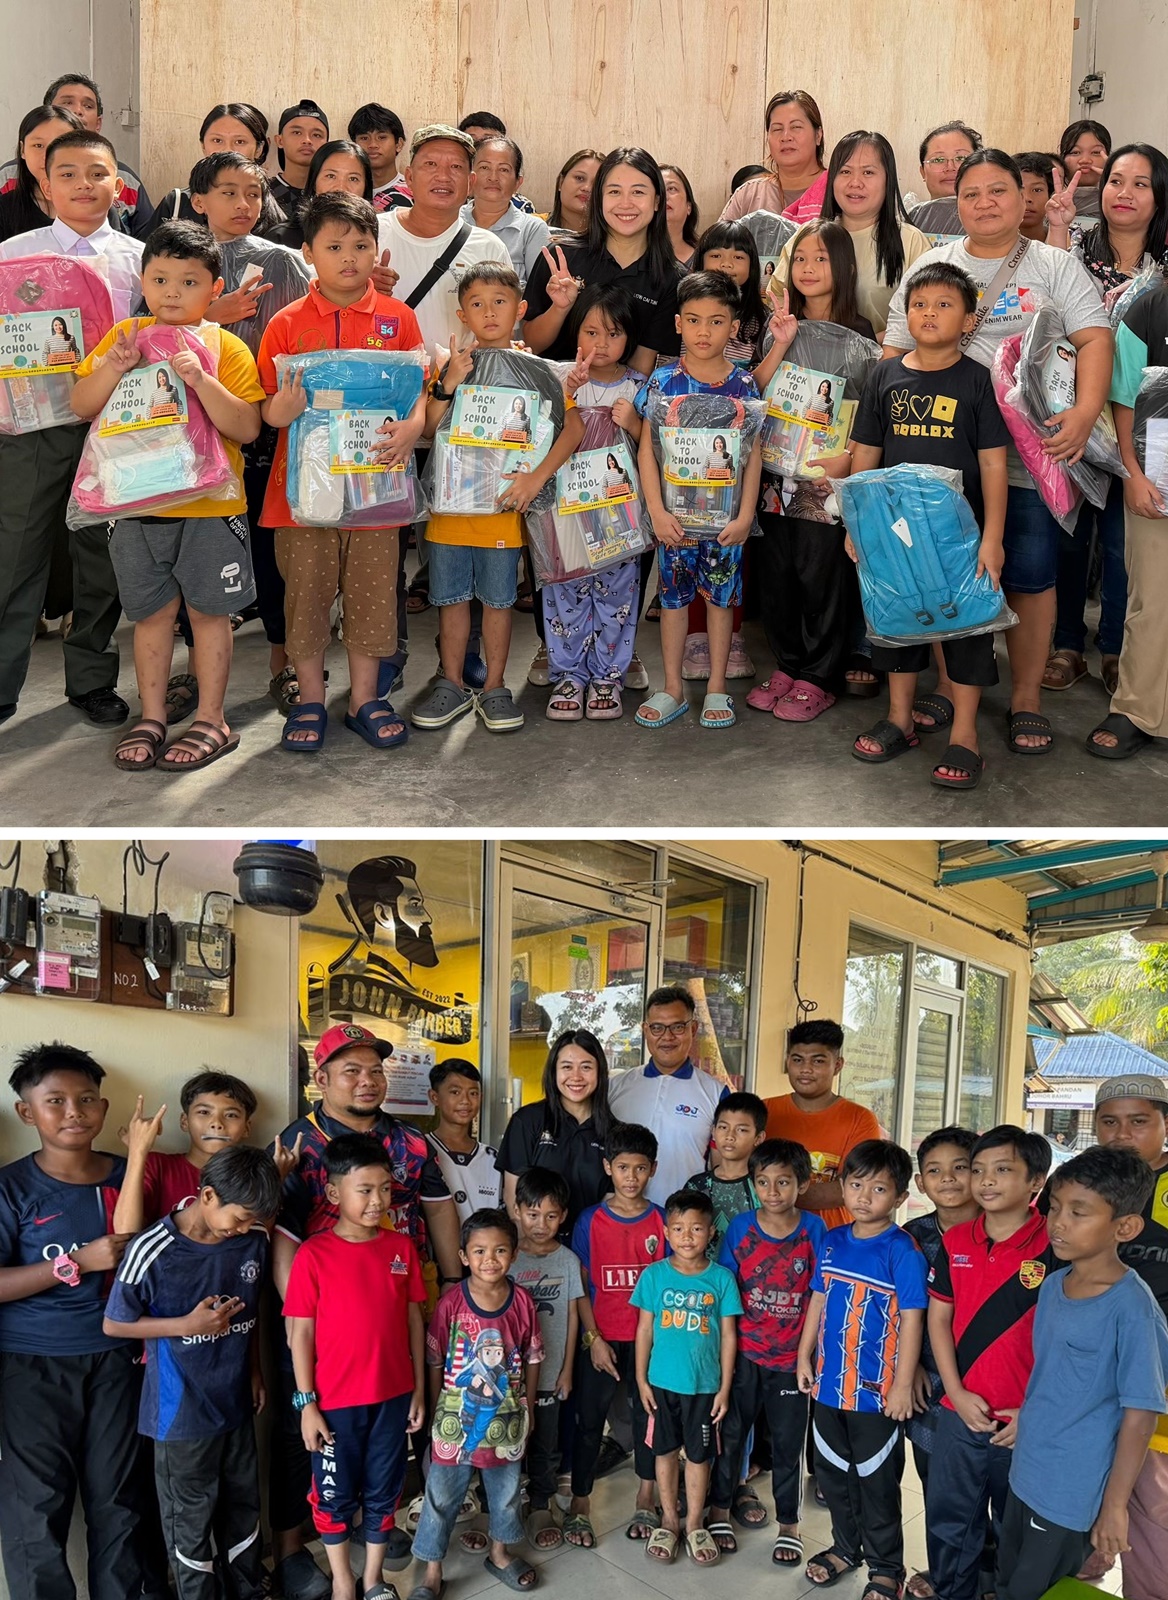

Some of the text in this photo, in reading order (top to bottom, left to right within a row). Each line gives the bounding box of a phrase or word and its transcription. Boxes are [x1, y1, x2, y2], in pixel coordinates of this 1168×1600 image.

[985, 314, 1023, 324] ENIM WEAR
[4, 322, 32, 333] BACK
[380, 324, 393, 336] 54
[12, 334, 25, 342] TO
[366, 336, 383, 348] 56
[0, 343, 40, 355] SCHOOL
[785, 371, 808, 385] BACK
[1049, 369, 1061, 391] BACK
[788, 381, 798, 391] TO
[1060, 380, 1067, 390] TO
[123, 389, 134, 399] TO
[472, 394, 496, 405] BACK
[776, 387, 804, 403] SCHOOL
[110, 398, 146, 411] SCHOOL
[477, 405, 488, 414] TO
[349, 419, 370, 429] BACK
[464, 413, 498, 425] SCHOOL
[354, 430, 364, 439] TO
[892, 423, 955, 439] ROBLOX
[674, 437, 697, 446] BACK
[680, 447, 690, 455] TO
[570, 460, 592, 471] BACK
[577, 471, 586, 480] TO
[567, 479, 600, 492] SCHOOL
[131, 974, 139, 988] 2
[422, 988, 451, 1003] EST 2022
[339, 978, 463, 1037] JOHN BARBER
[747, 1299, 802, 1314] FAN TOKEN
[660, 1309, 710, 1334] DUDE
